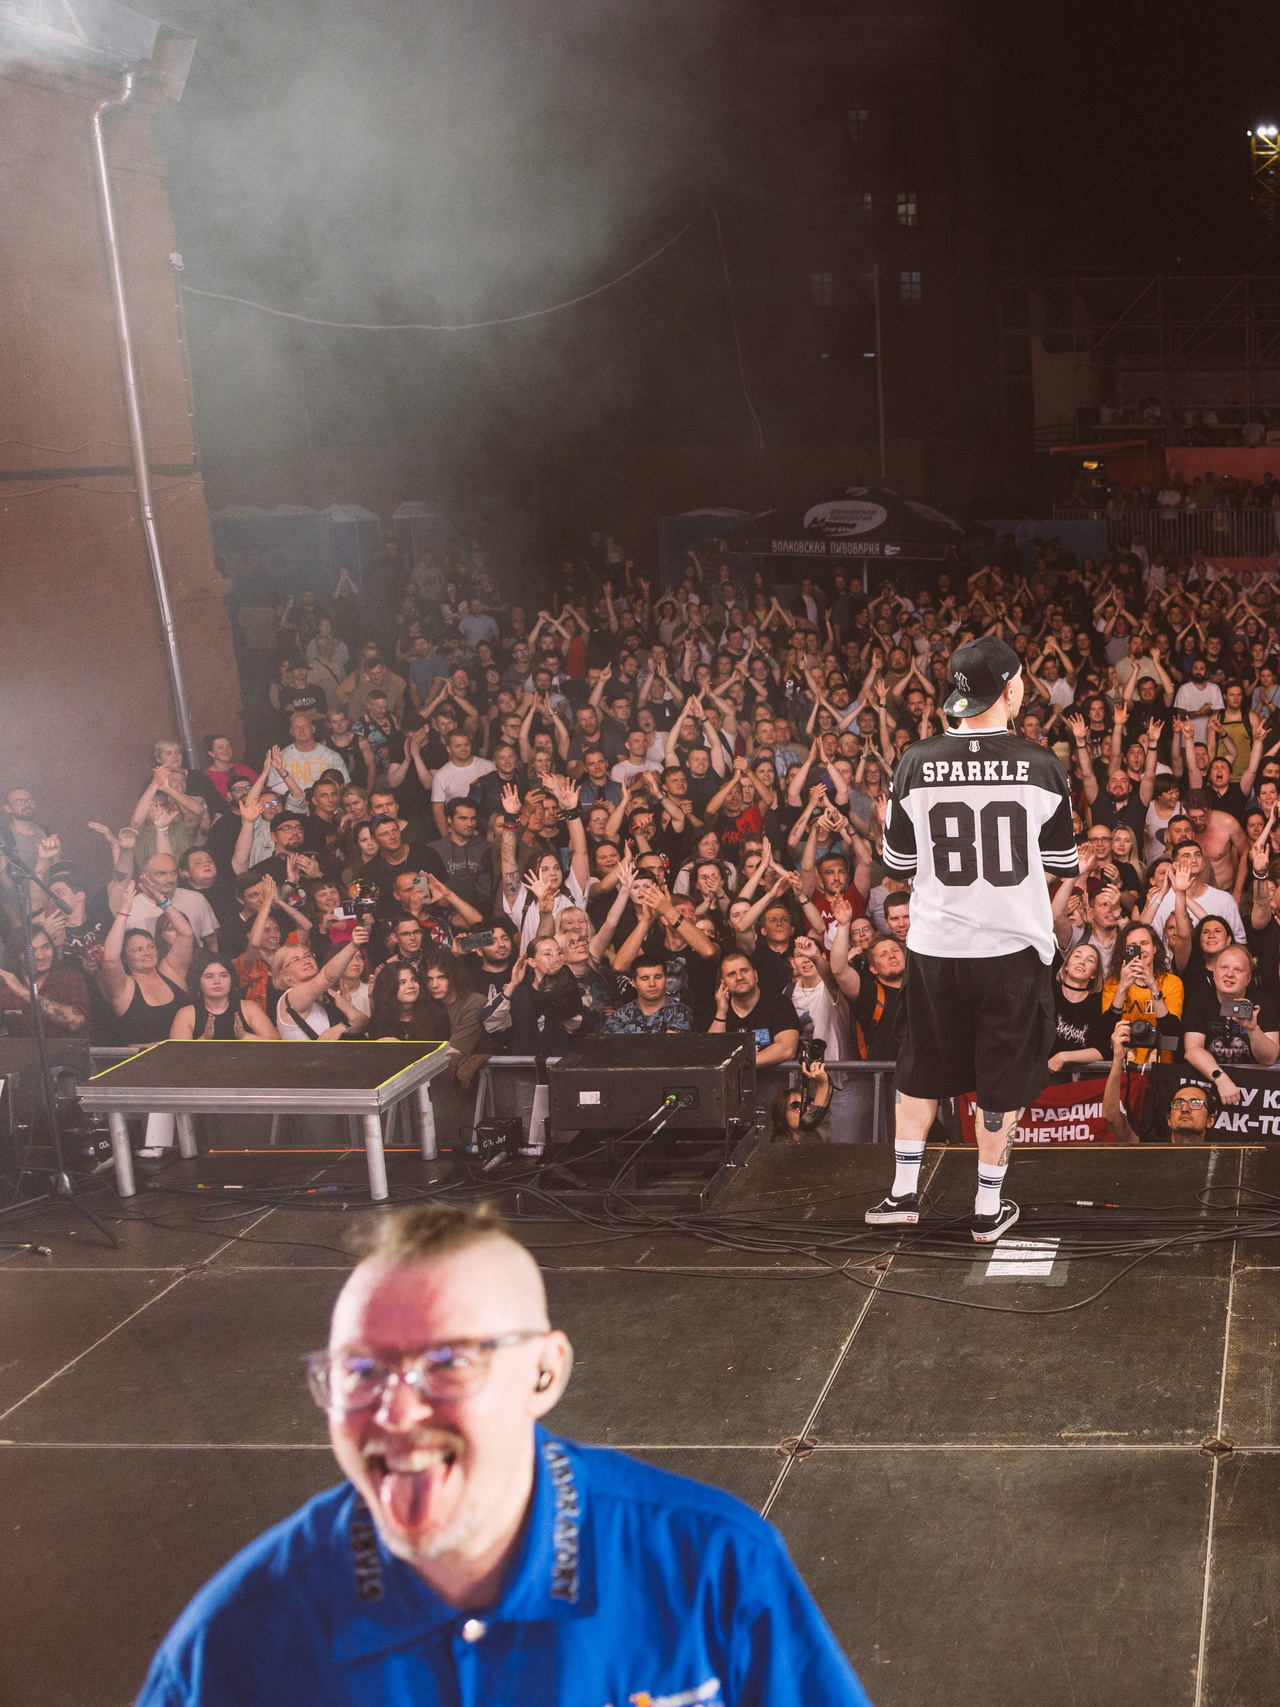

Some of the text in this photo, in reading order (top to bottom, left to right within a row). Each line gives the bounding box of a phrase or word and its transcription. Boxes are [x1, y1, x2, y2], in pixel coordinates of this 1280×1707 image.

[772, 541, 880, 555] ВОЛКОВСКАЯ ПИВОВАРНЯ
[922, 760, 1030, 782] SPARKLE
[928, 800, 1029, 887] 80
[1014, 1124, 1095, 1143] ОНЕЧНО,
